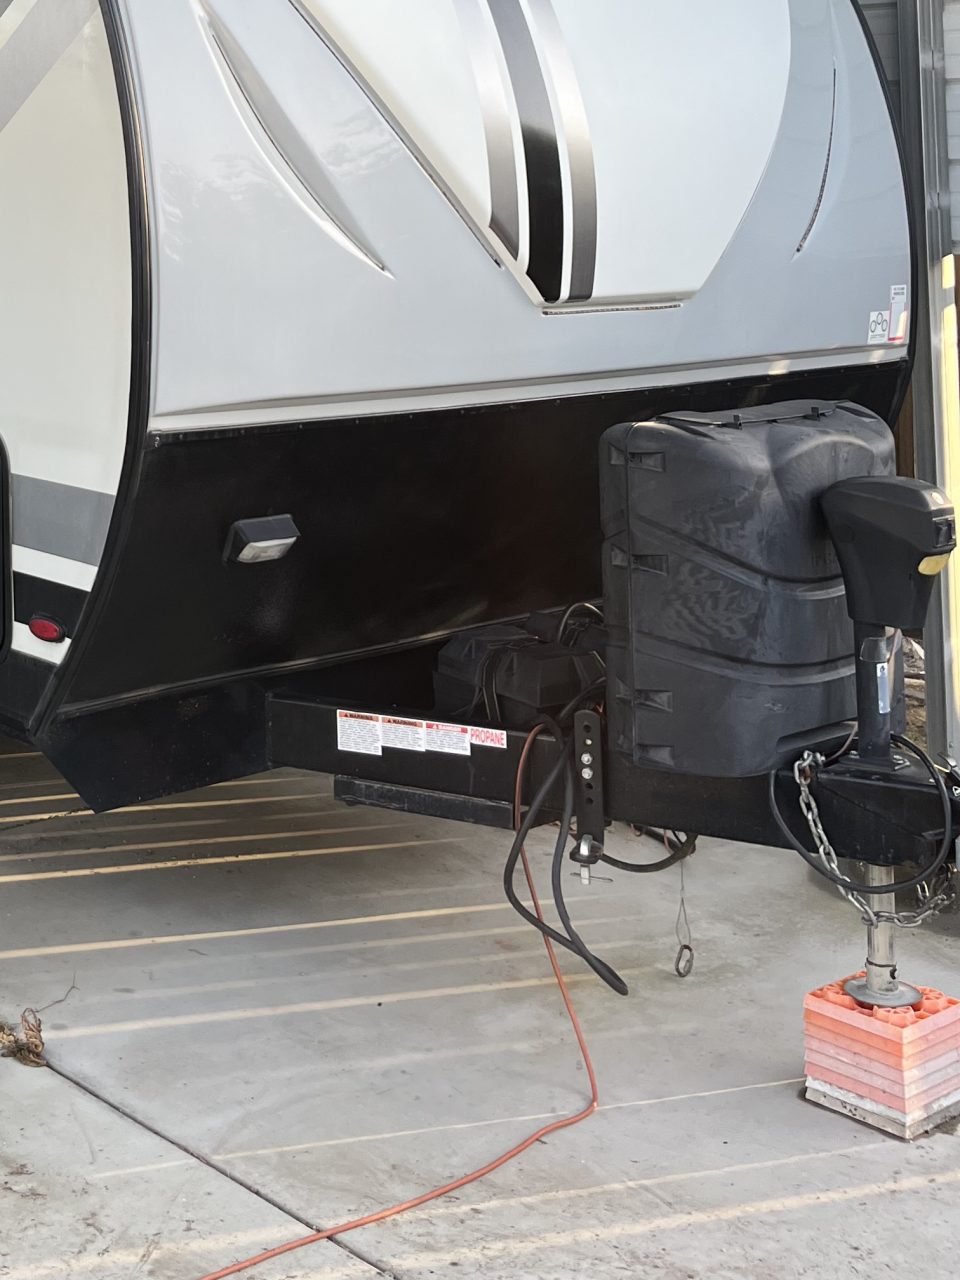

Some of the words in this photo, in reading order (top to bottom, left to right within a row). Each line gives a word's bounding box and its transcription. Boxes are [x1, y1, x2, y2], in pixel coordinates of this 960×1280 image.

[349, 713, 374, 721] WARNING
[392, 719, 418, 727] WARNING
[470, 728, 505, 746] PROPANE
